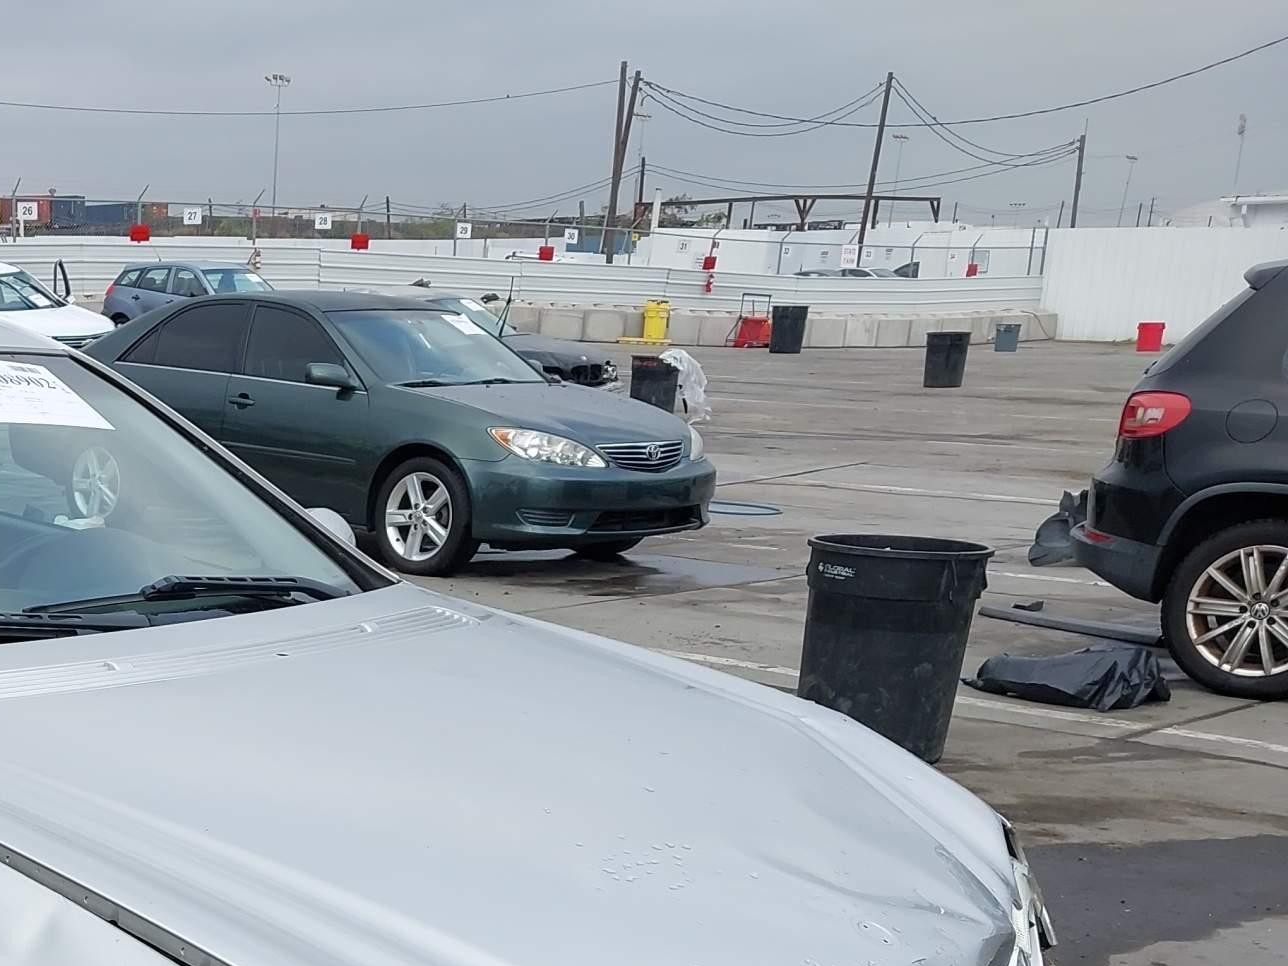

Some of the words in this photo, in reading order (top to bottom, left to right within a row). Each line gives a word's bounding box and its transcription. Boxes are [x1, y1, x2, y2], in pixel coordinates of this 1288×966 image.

[22, 206, 33, 216] 26
[187, 212, 197, 221] 27
[319, 216, 328, 225] 28
[459, 226, 468, 235] 29
